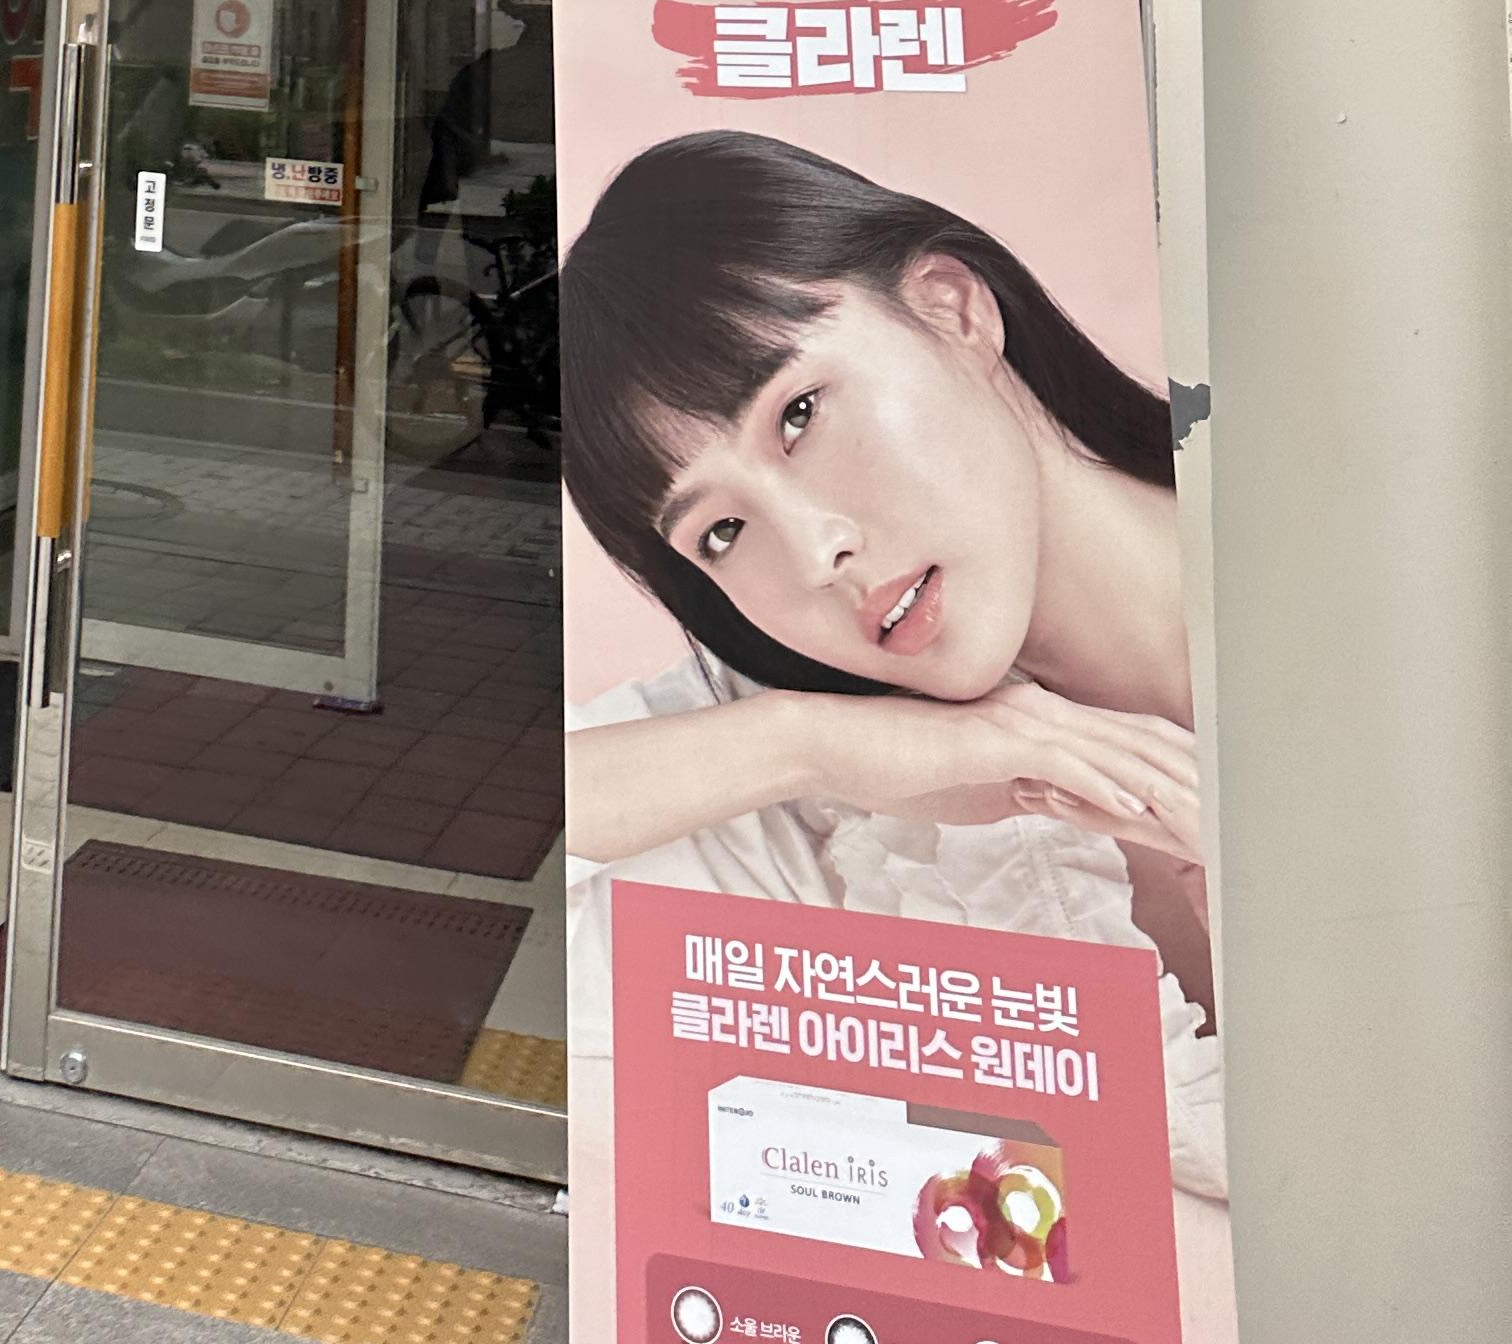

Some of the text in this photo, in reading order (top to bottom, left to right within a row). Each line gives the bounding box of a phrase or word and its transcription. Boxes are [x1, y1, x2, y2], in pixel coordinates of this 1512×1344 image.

[714, 6, 967, 93] 클라렌
[685, 934, 1079, 1037] 매일 자연스러운 눈빛
[671, 991, 1099, 1101] 클라렌 아이리스 원데이
[762, 1146, 838, 1180] Clalen
[791, 1185, 860, 1206] SOUL BROWN
[730, 1315, 801, 1344] 소울 브라운
